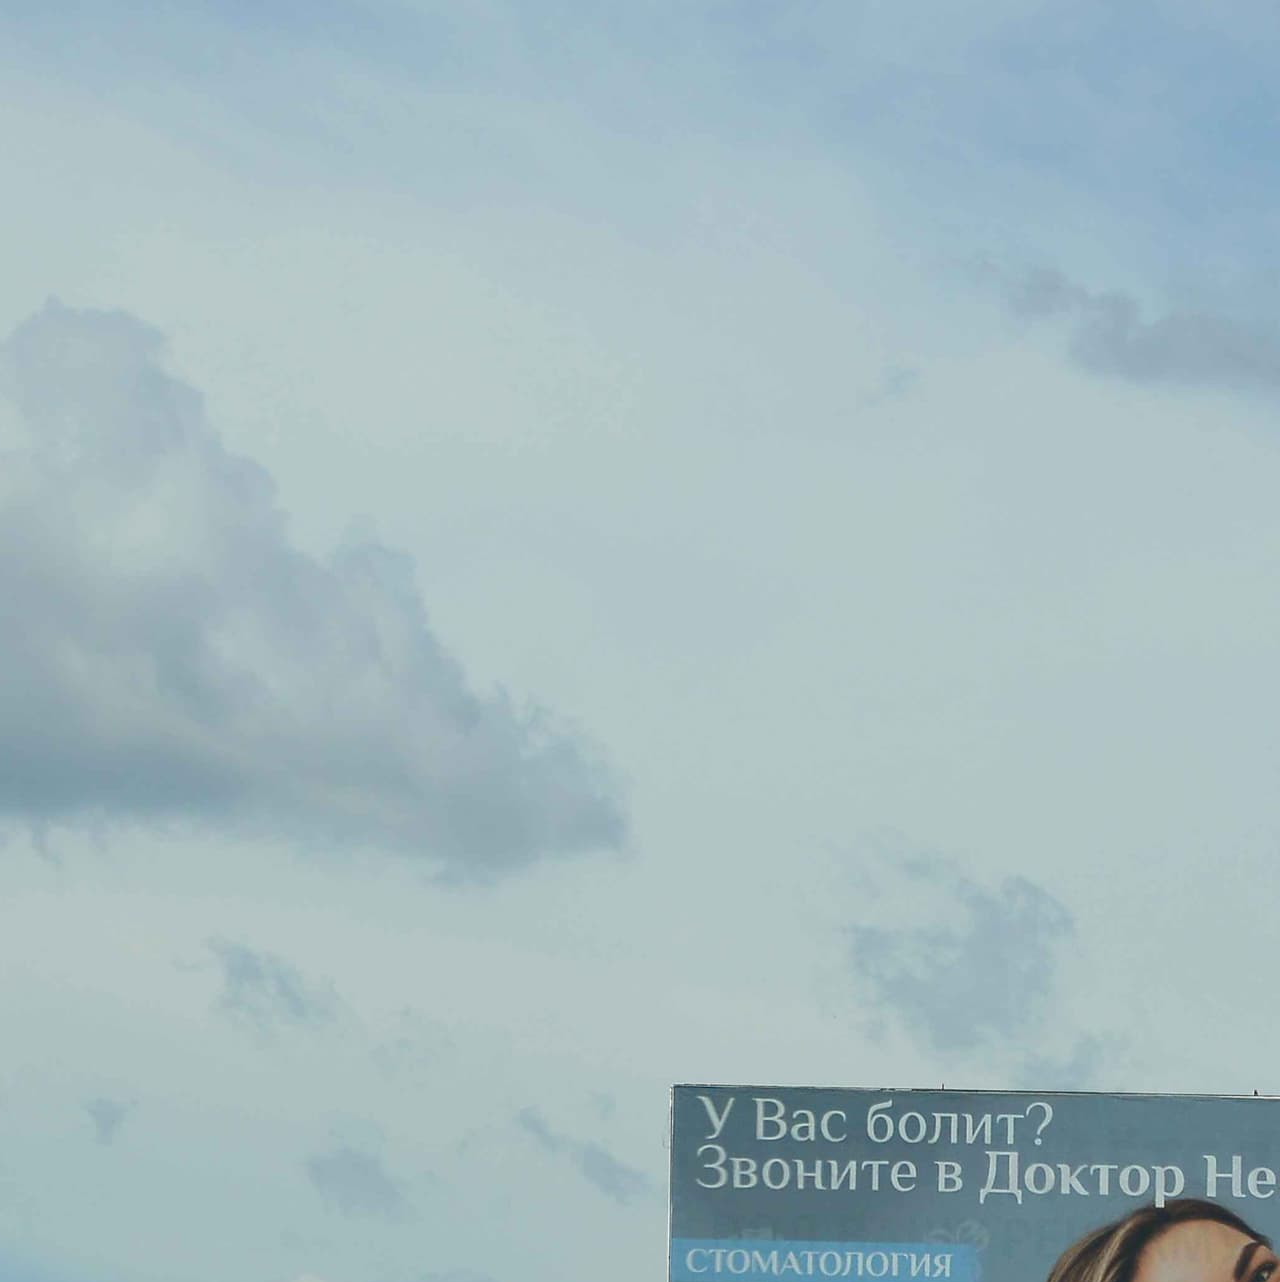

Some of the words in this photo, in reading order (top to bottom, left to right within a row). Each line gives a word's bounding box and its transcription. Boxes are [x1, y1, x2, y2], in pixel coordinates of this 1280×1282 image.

[696, 1095, 735, 1140] У
[752, 1097, 848, 1143] Вас
[866, 1099, 1054, 1146] болит?
[695, 1144, 917, 1191] Звоните
[934, 1160, 963, 1193] в
[979, 1151, 1186, 1208] Доктор
[685, 1247, 953, 1278] СТОМАТОЛОГИЯ
